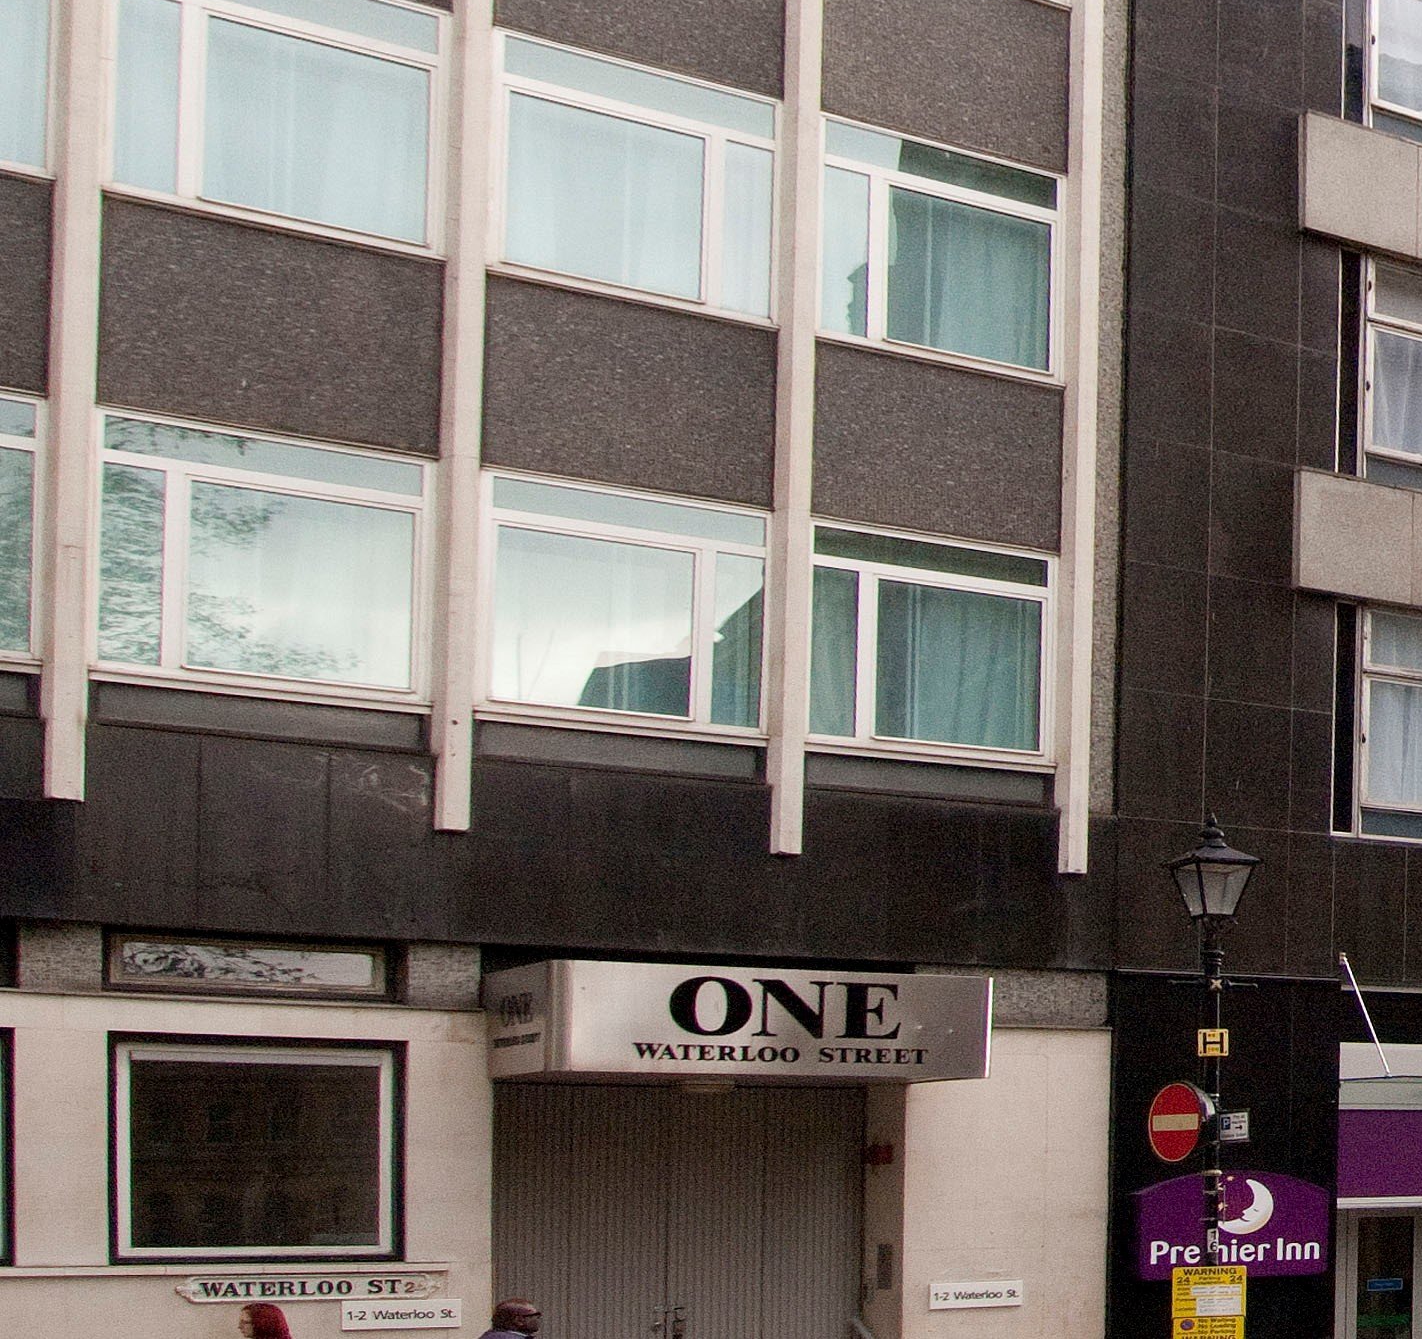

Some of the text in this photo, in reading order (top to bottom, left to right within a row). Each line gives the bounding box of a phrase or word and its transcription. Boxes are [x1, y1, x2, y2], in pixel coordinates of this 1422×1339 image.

[669, 976, 901, 1040] ONE
[1203, 1032, 1225, 1054] H
[632, 1042, 929, 1065] WATERLOO STREET
[1276, 1237, 1321, 1261] Inn
[1183, 1268, 1237, 1276] WARNING
[1229, 1275, 1243, 1283] 24
[199, 1280, 353, 1299] WATERLOO
[367, 1279, 402, 1295] ST
[934, 1288, 1020, 1301] 1-2 Waterloo St.
[346, 1308, 457, 1322] 1-2 Waterloo St.
